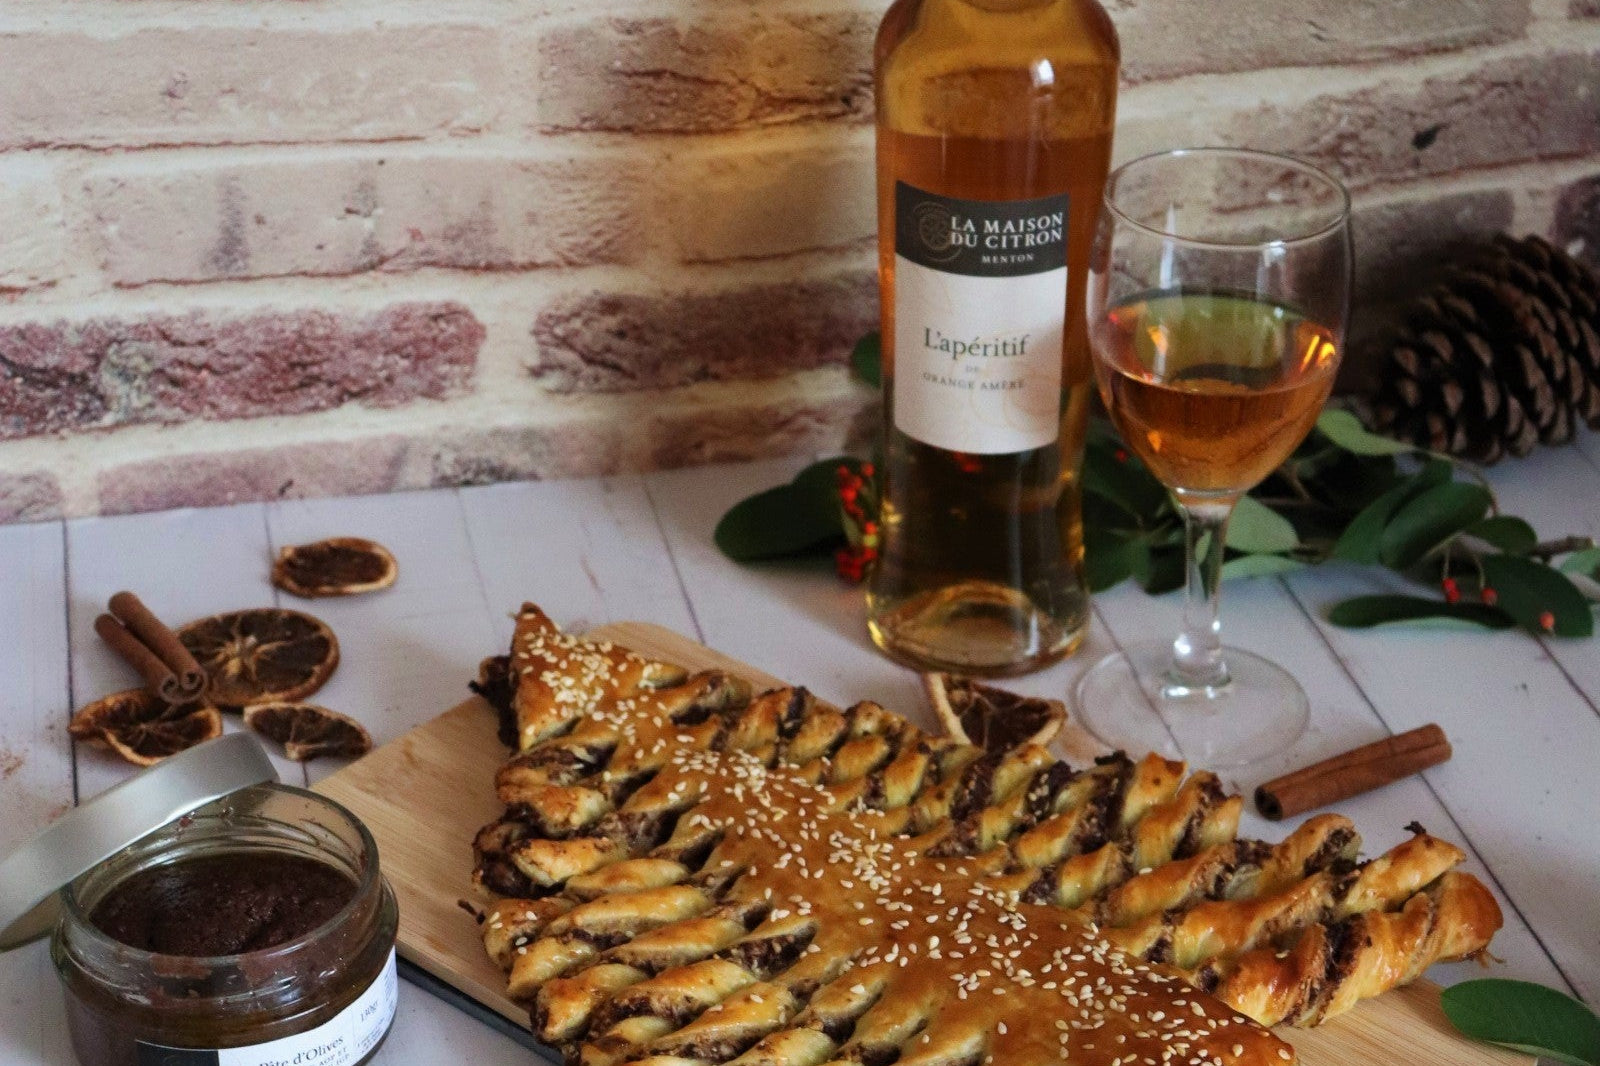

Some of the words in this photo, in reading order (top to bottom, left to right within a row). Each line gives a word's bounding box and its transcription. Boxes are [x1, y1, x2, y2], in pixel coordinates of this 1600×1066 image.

[951, 216, 976, 232] LA
[983, 211, 1063, 234] MAISON
[951, 232, 978, 248] DU
[985, 228, 1062, 249] CITRON
[981, 253, 1034, 264] MENTON
[923, 327, 1031, 360] L'apéritif
[923, 372, 975, 390] ORANGE
[293, 1035, 344, 1065] d'Olives
